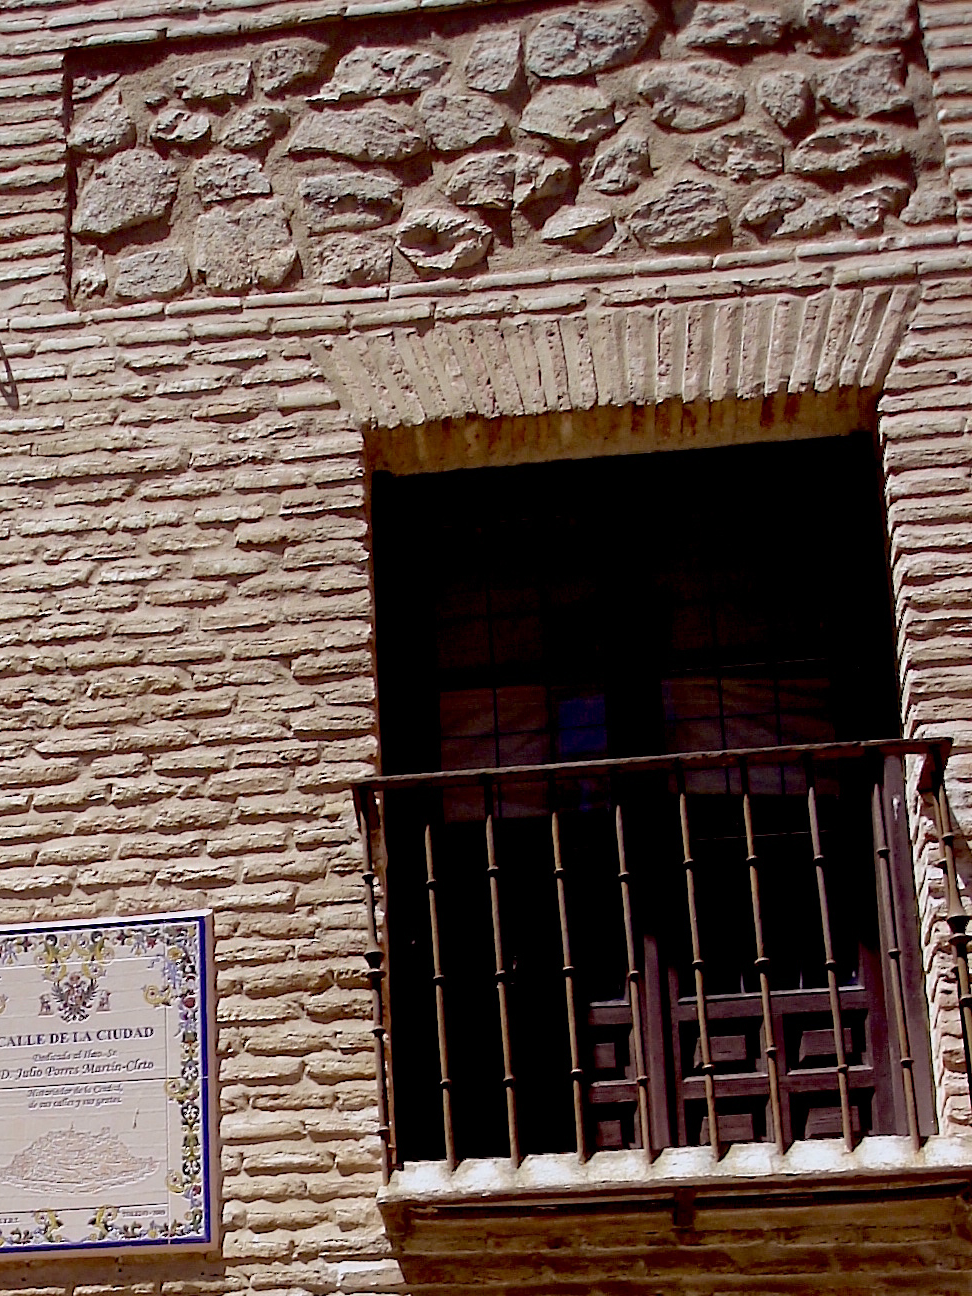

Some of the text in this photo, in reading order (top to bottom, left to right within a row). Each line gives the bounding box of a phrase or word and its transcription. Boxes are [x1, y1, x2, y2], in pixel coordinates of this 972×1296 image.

[49, 1032, 69, 1044] DE
[73, 1031, 92, 1042] LA
[96, 1027, 154, 1040] CIUDAD
[15, 1066, 43, 1080] Julio
